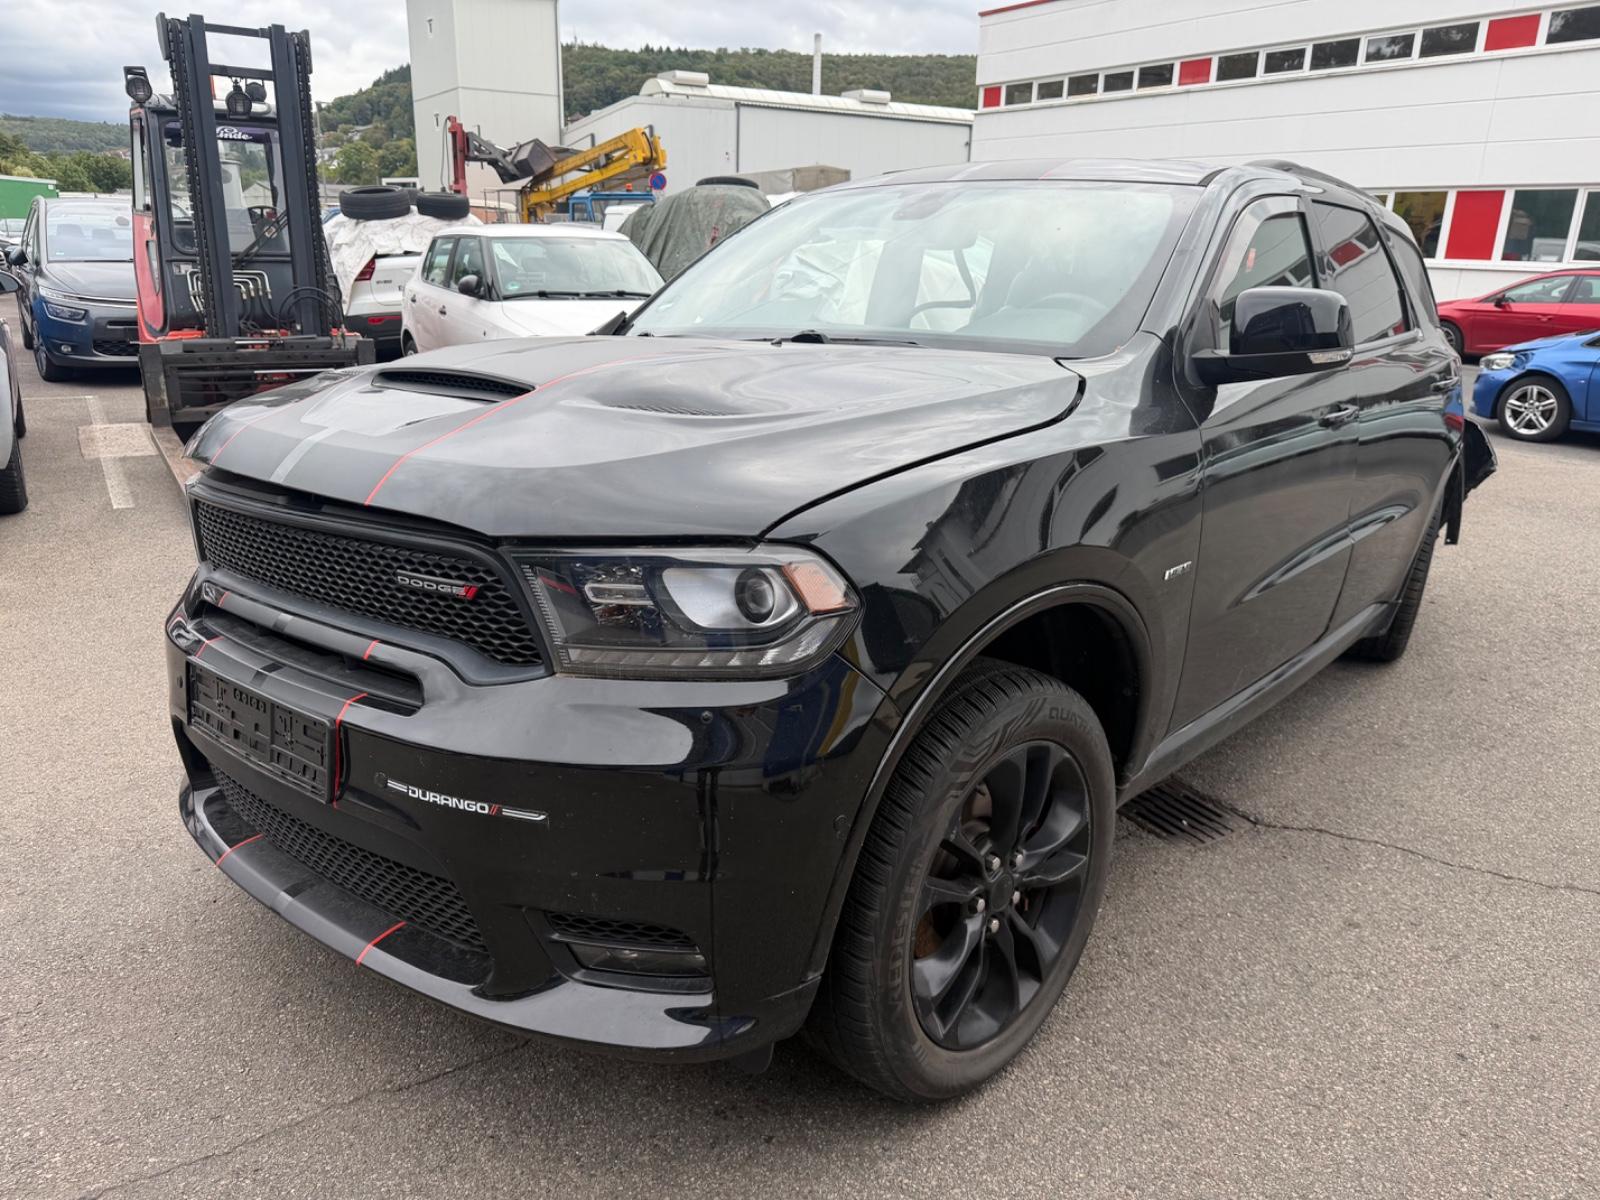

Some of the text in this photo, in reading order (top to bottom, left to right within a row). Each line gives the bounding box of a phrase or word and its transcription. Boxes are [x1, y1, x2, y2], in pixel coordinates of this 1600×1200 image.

[216, 126, 253, 140] inde
[397, 576, 466, 596] DODGE
[408, 786, 490, 814] DURANGO
